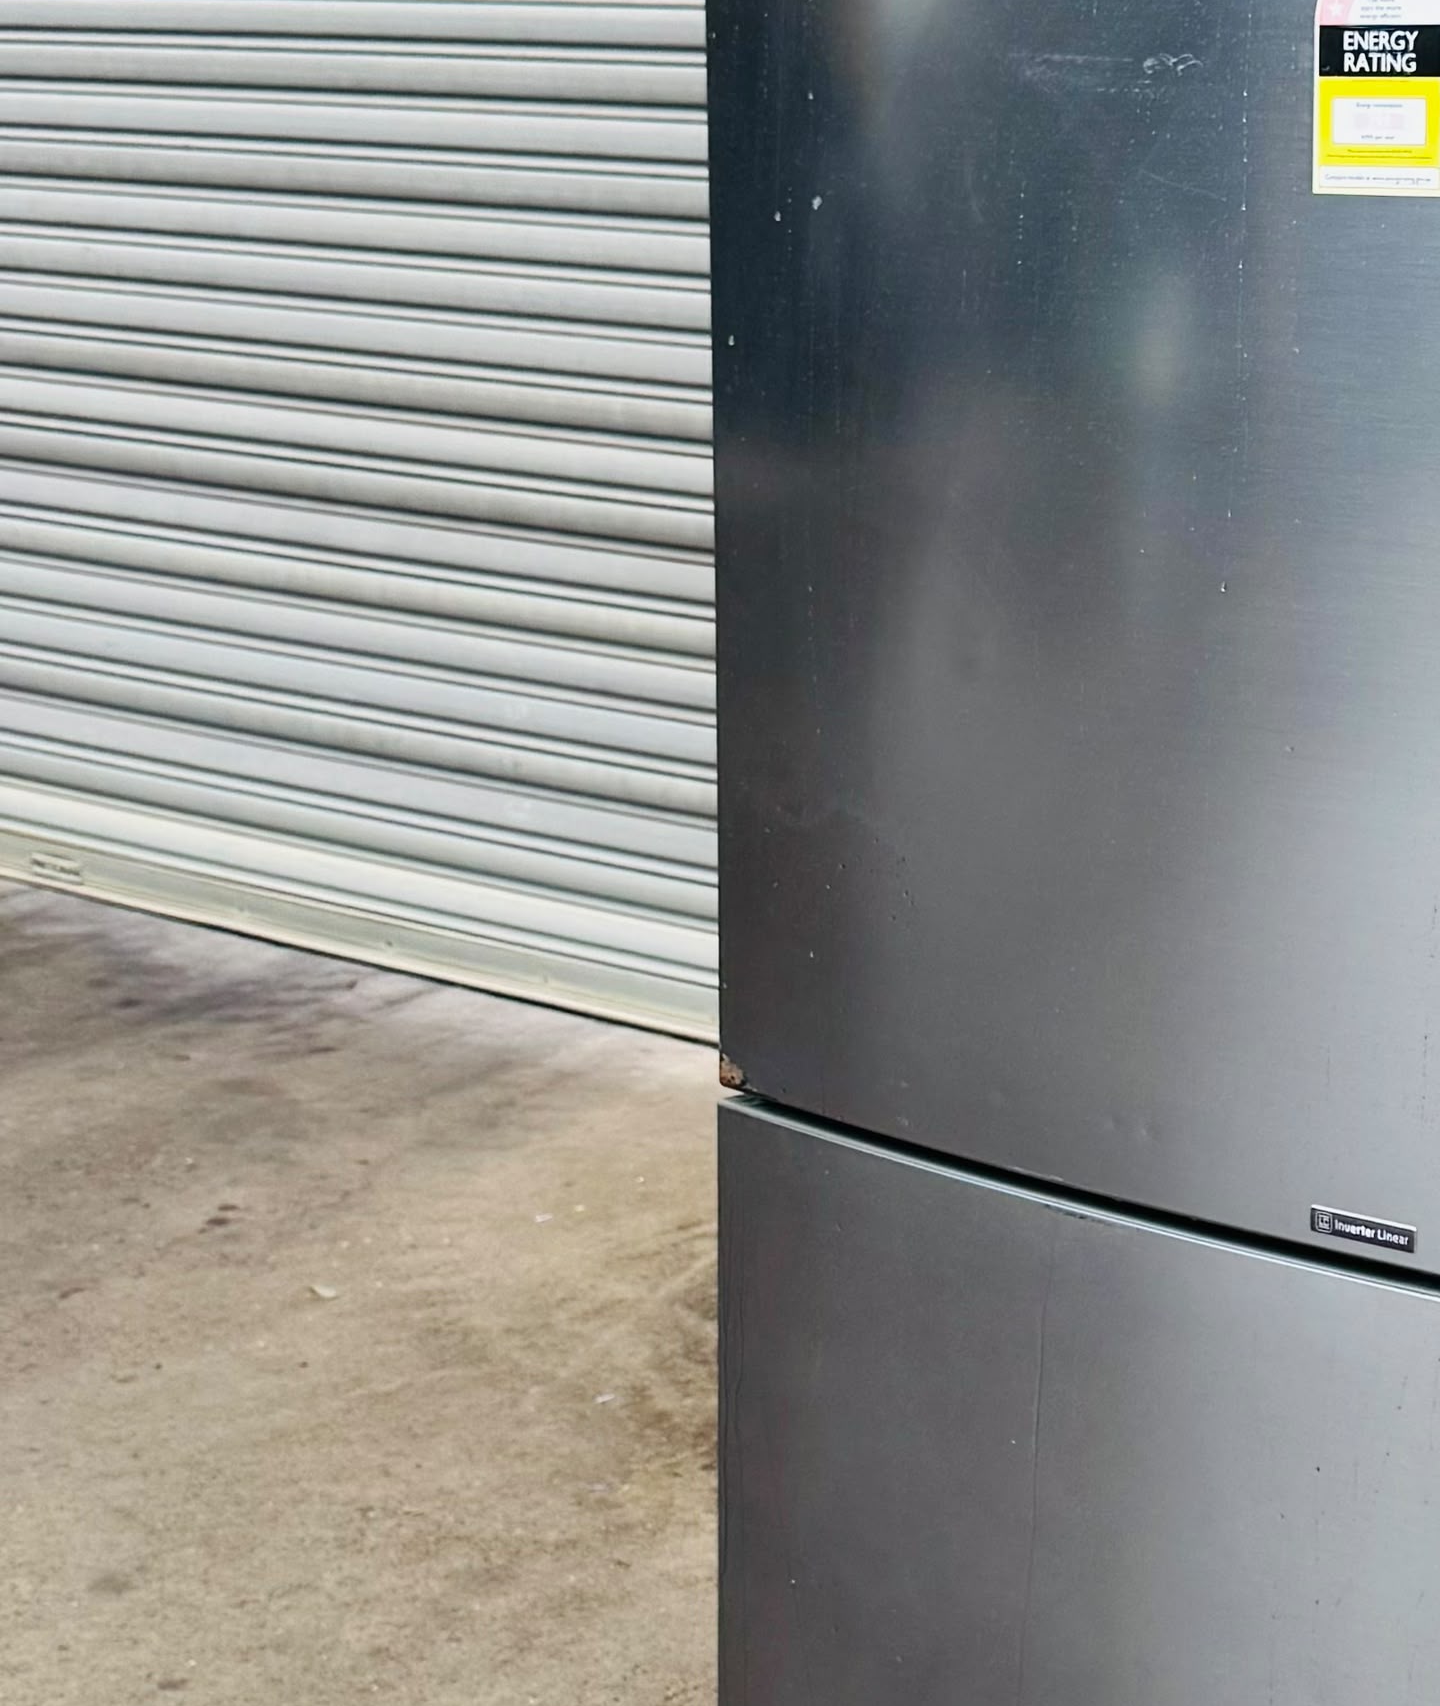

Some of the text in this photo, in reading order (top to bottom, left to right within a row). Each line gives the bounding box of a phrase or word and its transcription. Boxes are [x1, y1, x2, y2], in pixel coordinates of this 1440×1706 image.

[1343, 30, 1419, 51] ENERGY
[1343, 52, 1417, 72] RATING
[1334, 1219, 1375, 1238] Inverter
[1377, 1229, 1409, 1245] Linear
